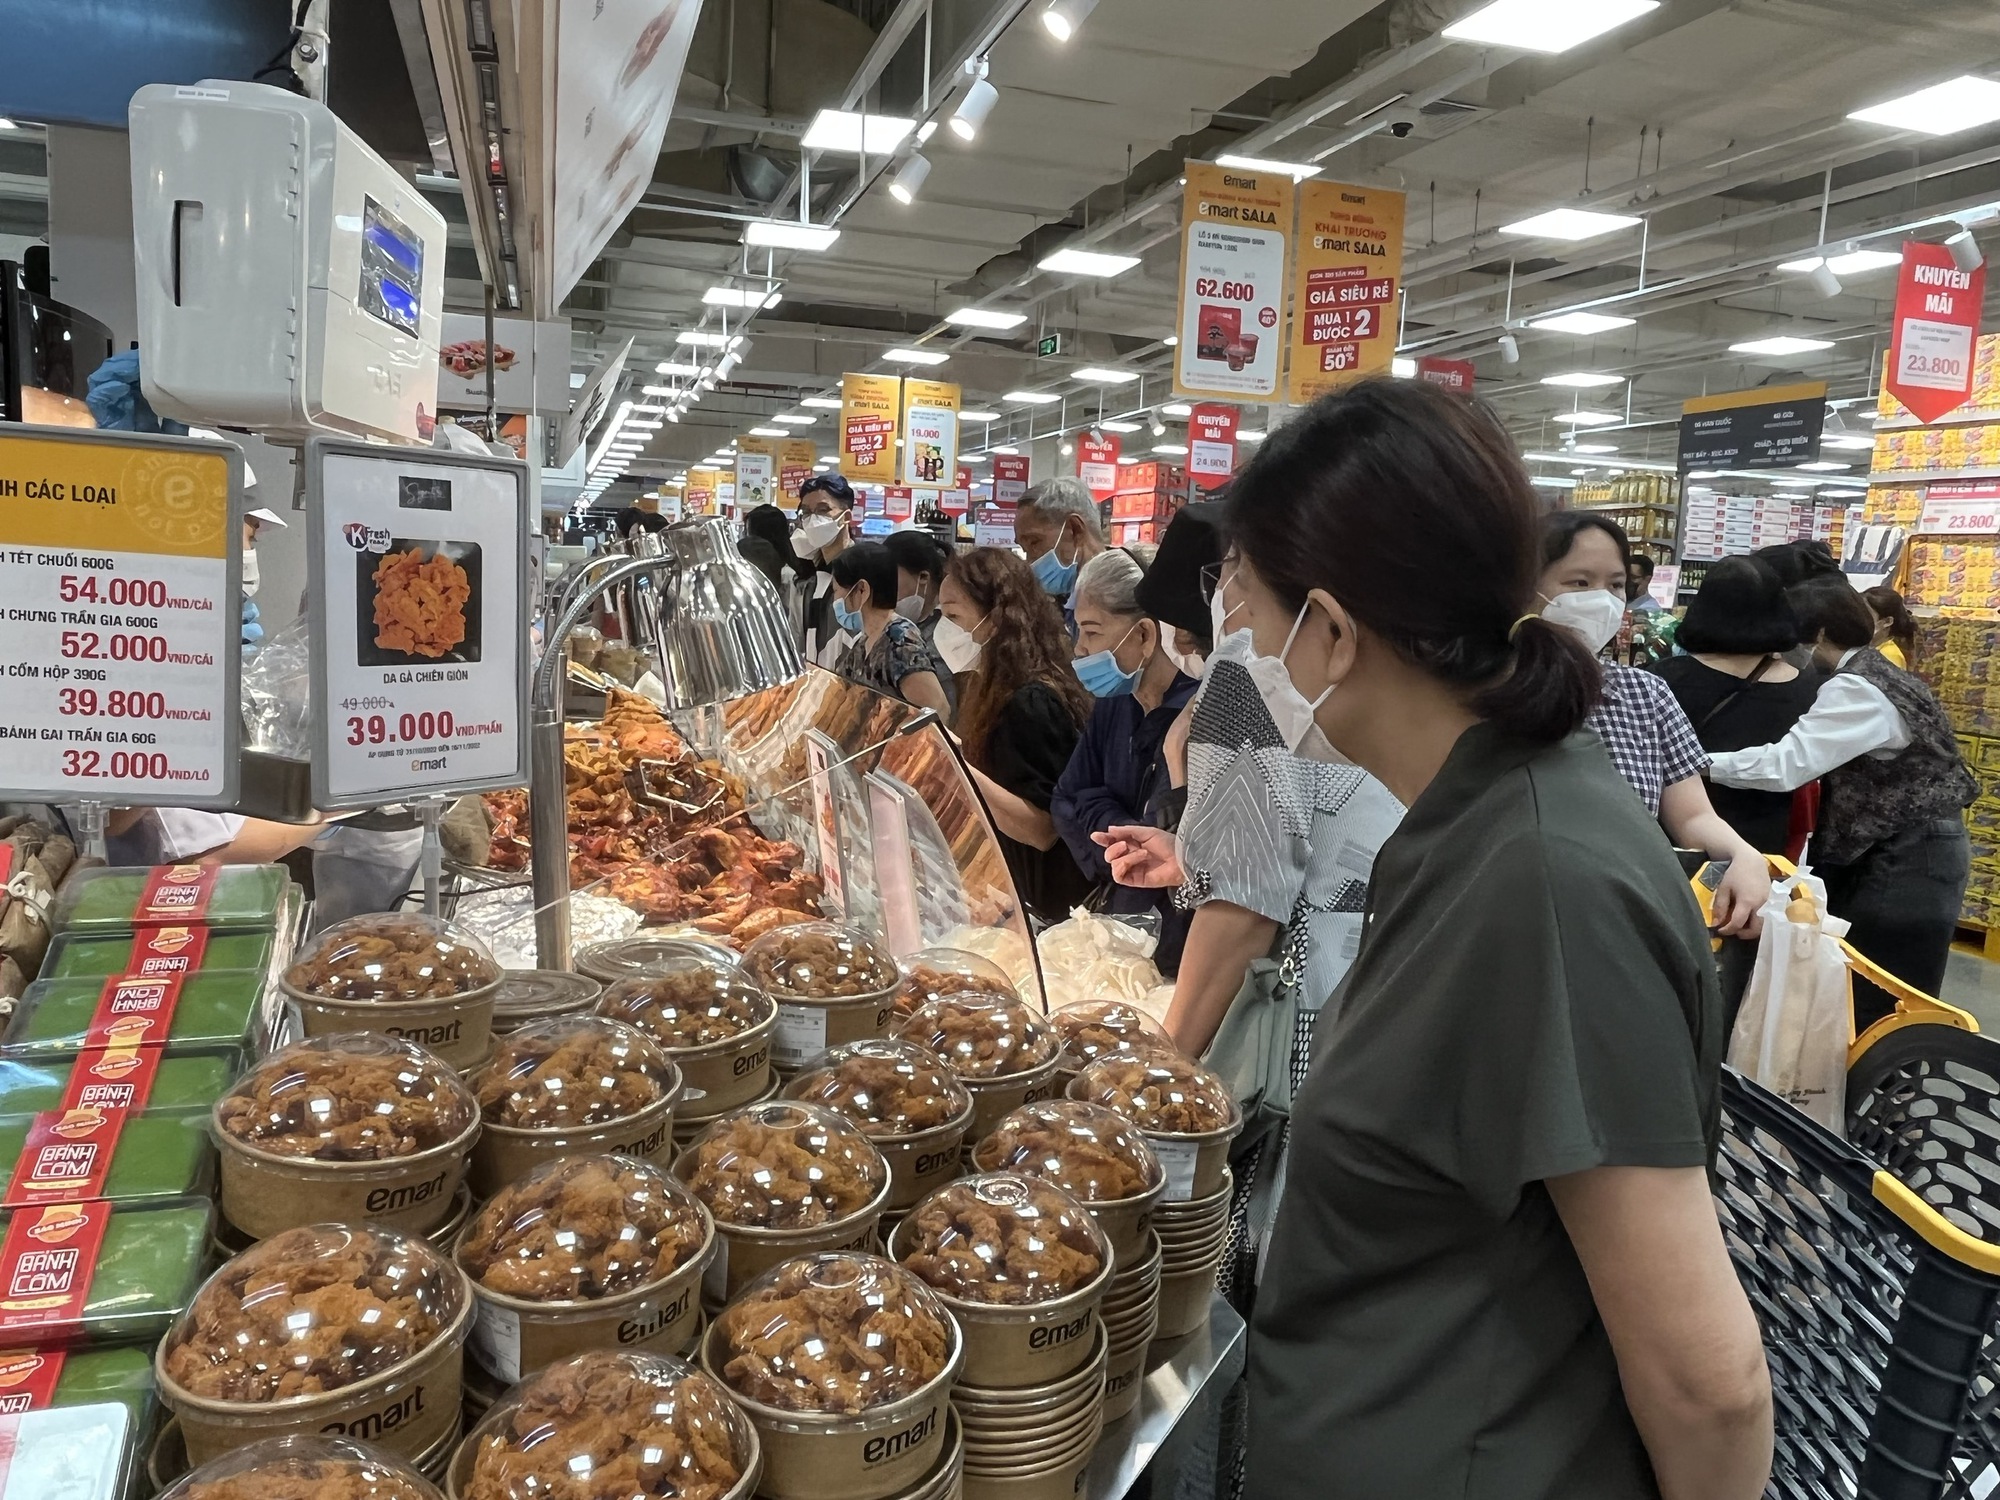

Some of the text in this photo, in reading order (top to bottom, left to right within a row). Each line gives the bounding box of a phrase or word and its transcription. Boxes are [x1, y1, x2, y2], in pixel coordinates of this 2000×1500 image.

[1223, 174, 1257, 191] emart
[1198, 201, 1277, 225] emart SALA
[1314, 221, 1341, 235] KHAI
[1313, 235, 1386, 257] emart SALA
[1196, 277, 1255, 302] 62.600
[1309, 286, 1337, 305] GIÁ
[1339, 284, 1369, 302] SIÊU
[1313, 311, 1351, 327] MUA 1
[1353, 308, 1372, 336] 2
[1324, 352, 1355, 371] 50%
[1906, 354, 1960, 376] 23.800
[872, 434, 883, 450] 2
[911, 428, 940, 439] 19.000
[25, 478, 65, 501] CÁC
[71, 484, 117, 510] LOẠI
[1947, 514, 1995, 529] 23.800
[37, 552, 78, 568] CHUỐI
[81, 557, 114, 571] 600G
[59, 574, 213, 611] 54.000 VND/CÁI
[9, 609, 57, 624] CHƯNG
[100, 615, 123, 627] GIA
[125, 616, 158, 629] 600G
[60, 631, 213, 666] 52.000 VND/CÁI
[9, 661, 39, 678] CỐM
[43, 664, 70, 683] HỘP
[73, 668, 106, 681] 390G
[383, 672, 397, 684] DA
[399, 670, 414, 683] GÀ
[58, 687, 211, 721] 39.800 VND/CÁI
[341, 696, 388, 711] 49.000
[0, 725, 37, 740] BÁNH
[41, 728, 63, 741] GAI
[106, 731, 129, 744] GIA
[132, 732, 157, 745] 60G
[346, 711, 454, 746] 39.000
[61, 749, 168, 780] 32.000
[411, 756, 447, 772] emart
[83, 1084, 131, 1101] BÁNH
[41, 1144, 93, 1161] BÁNH
[366, 1171, 447, 1213] emart
[20, 1250, 74, 1273] BÁNH
[14, 1271, 69, 1293] CỐM
[1029, 1307, 1093, 1349] emart
[863, 1407, 938, 1464] emart
